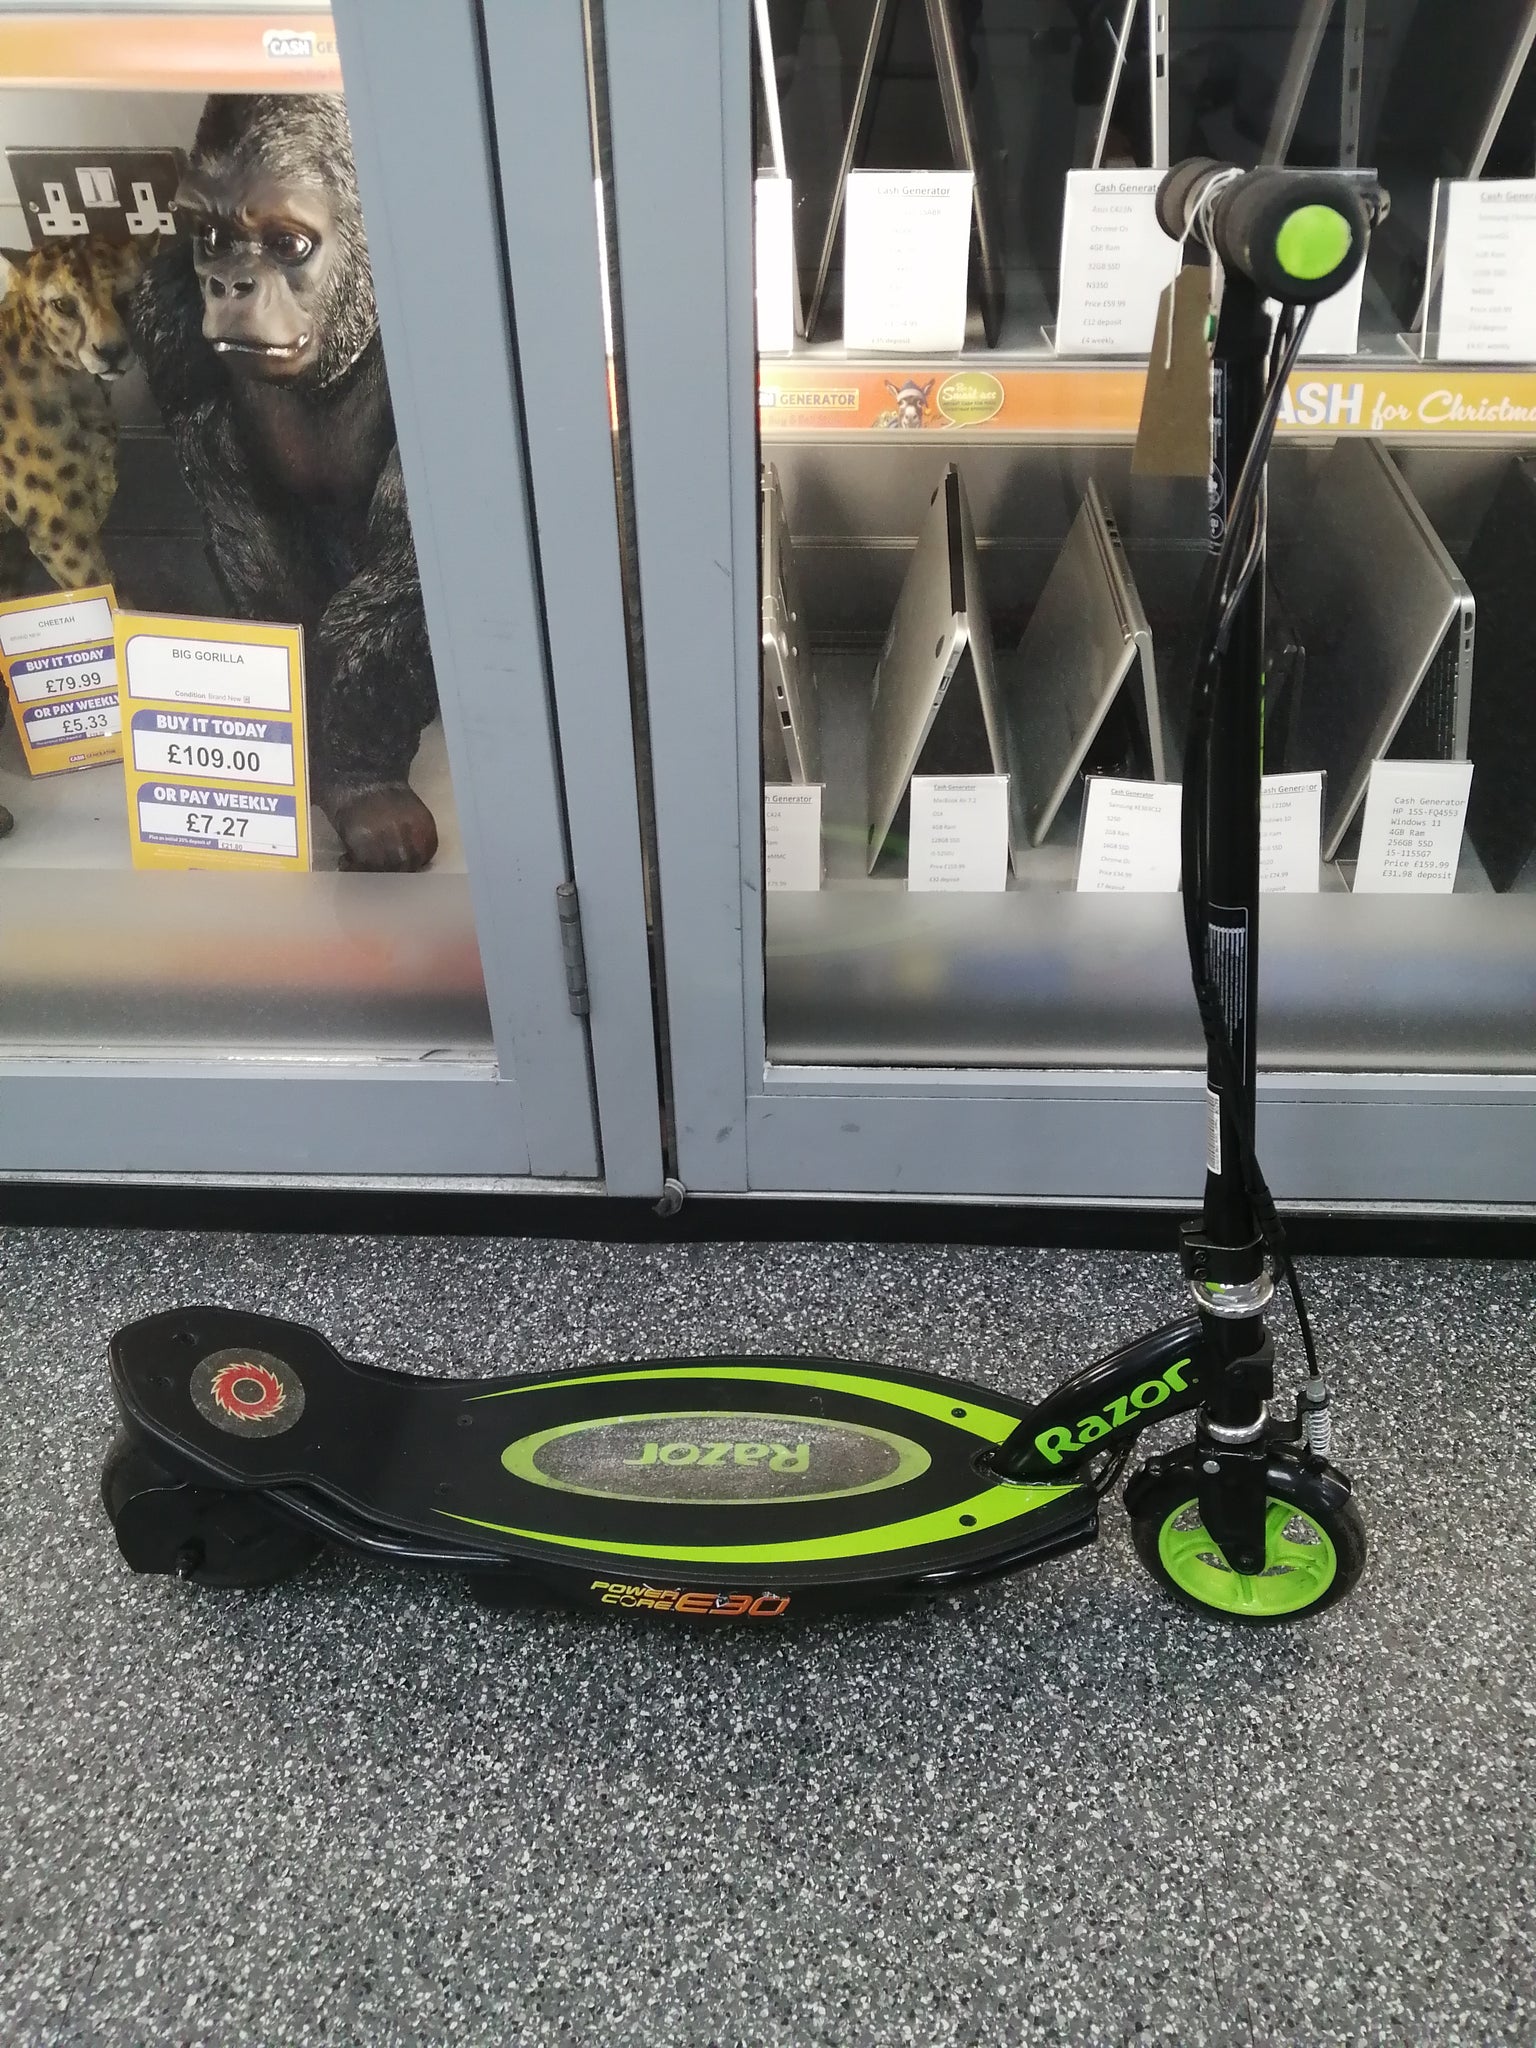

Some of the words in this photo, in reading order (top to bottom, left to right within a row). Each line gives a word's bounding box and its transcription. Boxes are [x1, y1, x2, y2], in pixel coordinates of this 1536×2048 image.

[270, 38, 311, 56] CASH
[902, 185, 950, 195] Generator
[1094, 183, 1116, 192] Cash
[1119, 183, 1158, 192] Generat
[1084, 299, 1101, 307] Price
[1097, 318, 1122, 328] deposit
[1091, 336, 1115, 346] weekly
[780, 394, 856, 406] GENERATOR
[1277, 382, 1364, 425] ASH
[1371, 391, 1412, 430] for
[38, 616, 76, 628] CHEETAH
[26, 657, 50, 672] BUY
[51, 654, 64, 667] IT
[65, 649, 105, 665] TODAY
[172, 649, 192, 660] BIG
[195, 650, 245, 665] GORILLA
[46, 672, 102, 693] £79.99
[34, 706, 52, 719] OR
[53, 701, 75, 716] PAY
[63, 714, 108, 734] £5.33
[156, 714, 187, 732] BUY
[189, 717, 210, 735] IT
[211, 719, 268, 739] TODAY
[167, 744, 260, 772] £109.00
[1111, 788, 1124, 796] Cash
[1125, 791, 1154, 799] Generator
[1262, 786, 1277, 794] ash
[1278, 784, 1318, 793] Generator
[153, 786, 178, 803] OR
[179, 789, 211, 806] PAY
[212, 792, 279, 812] WEEKLY
[772, 795, 812, 803] Generator
[1394, 797, 1416, 805] Cash
[1419, 798, 1467, 807] Generator
[1392, 807, 1404, 815] HP
[186, 812, 249, 838] £7.27
[1390, 818, 1427, 827] Windows
[1430, 819, 1442, 828] 11
[1409, 829, 1426, 837] Ram
[1387, 839, 1414, 847] 256GB
[1418, 840, 1435, 848] SSD
[1386, 849, 1432, 858] i5-1155G7
[1384, 859, 1410, 868] Price
[1413, 861, 1450, 869] £159.99
[1382, 869, 1413, 878] £31.98
[1417, 871, 1453, 880] deposit
[1034, 1358, 1191, 1464] Razor
[622, 1442, 810, 1473] Razor
[590, 1580, 681, 1601] POWER
[601, 1593, 674, 1611] CORE
